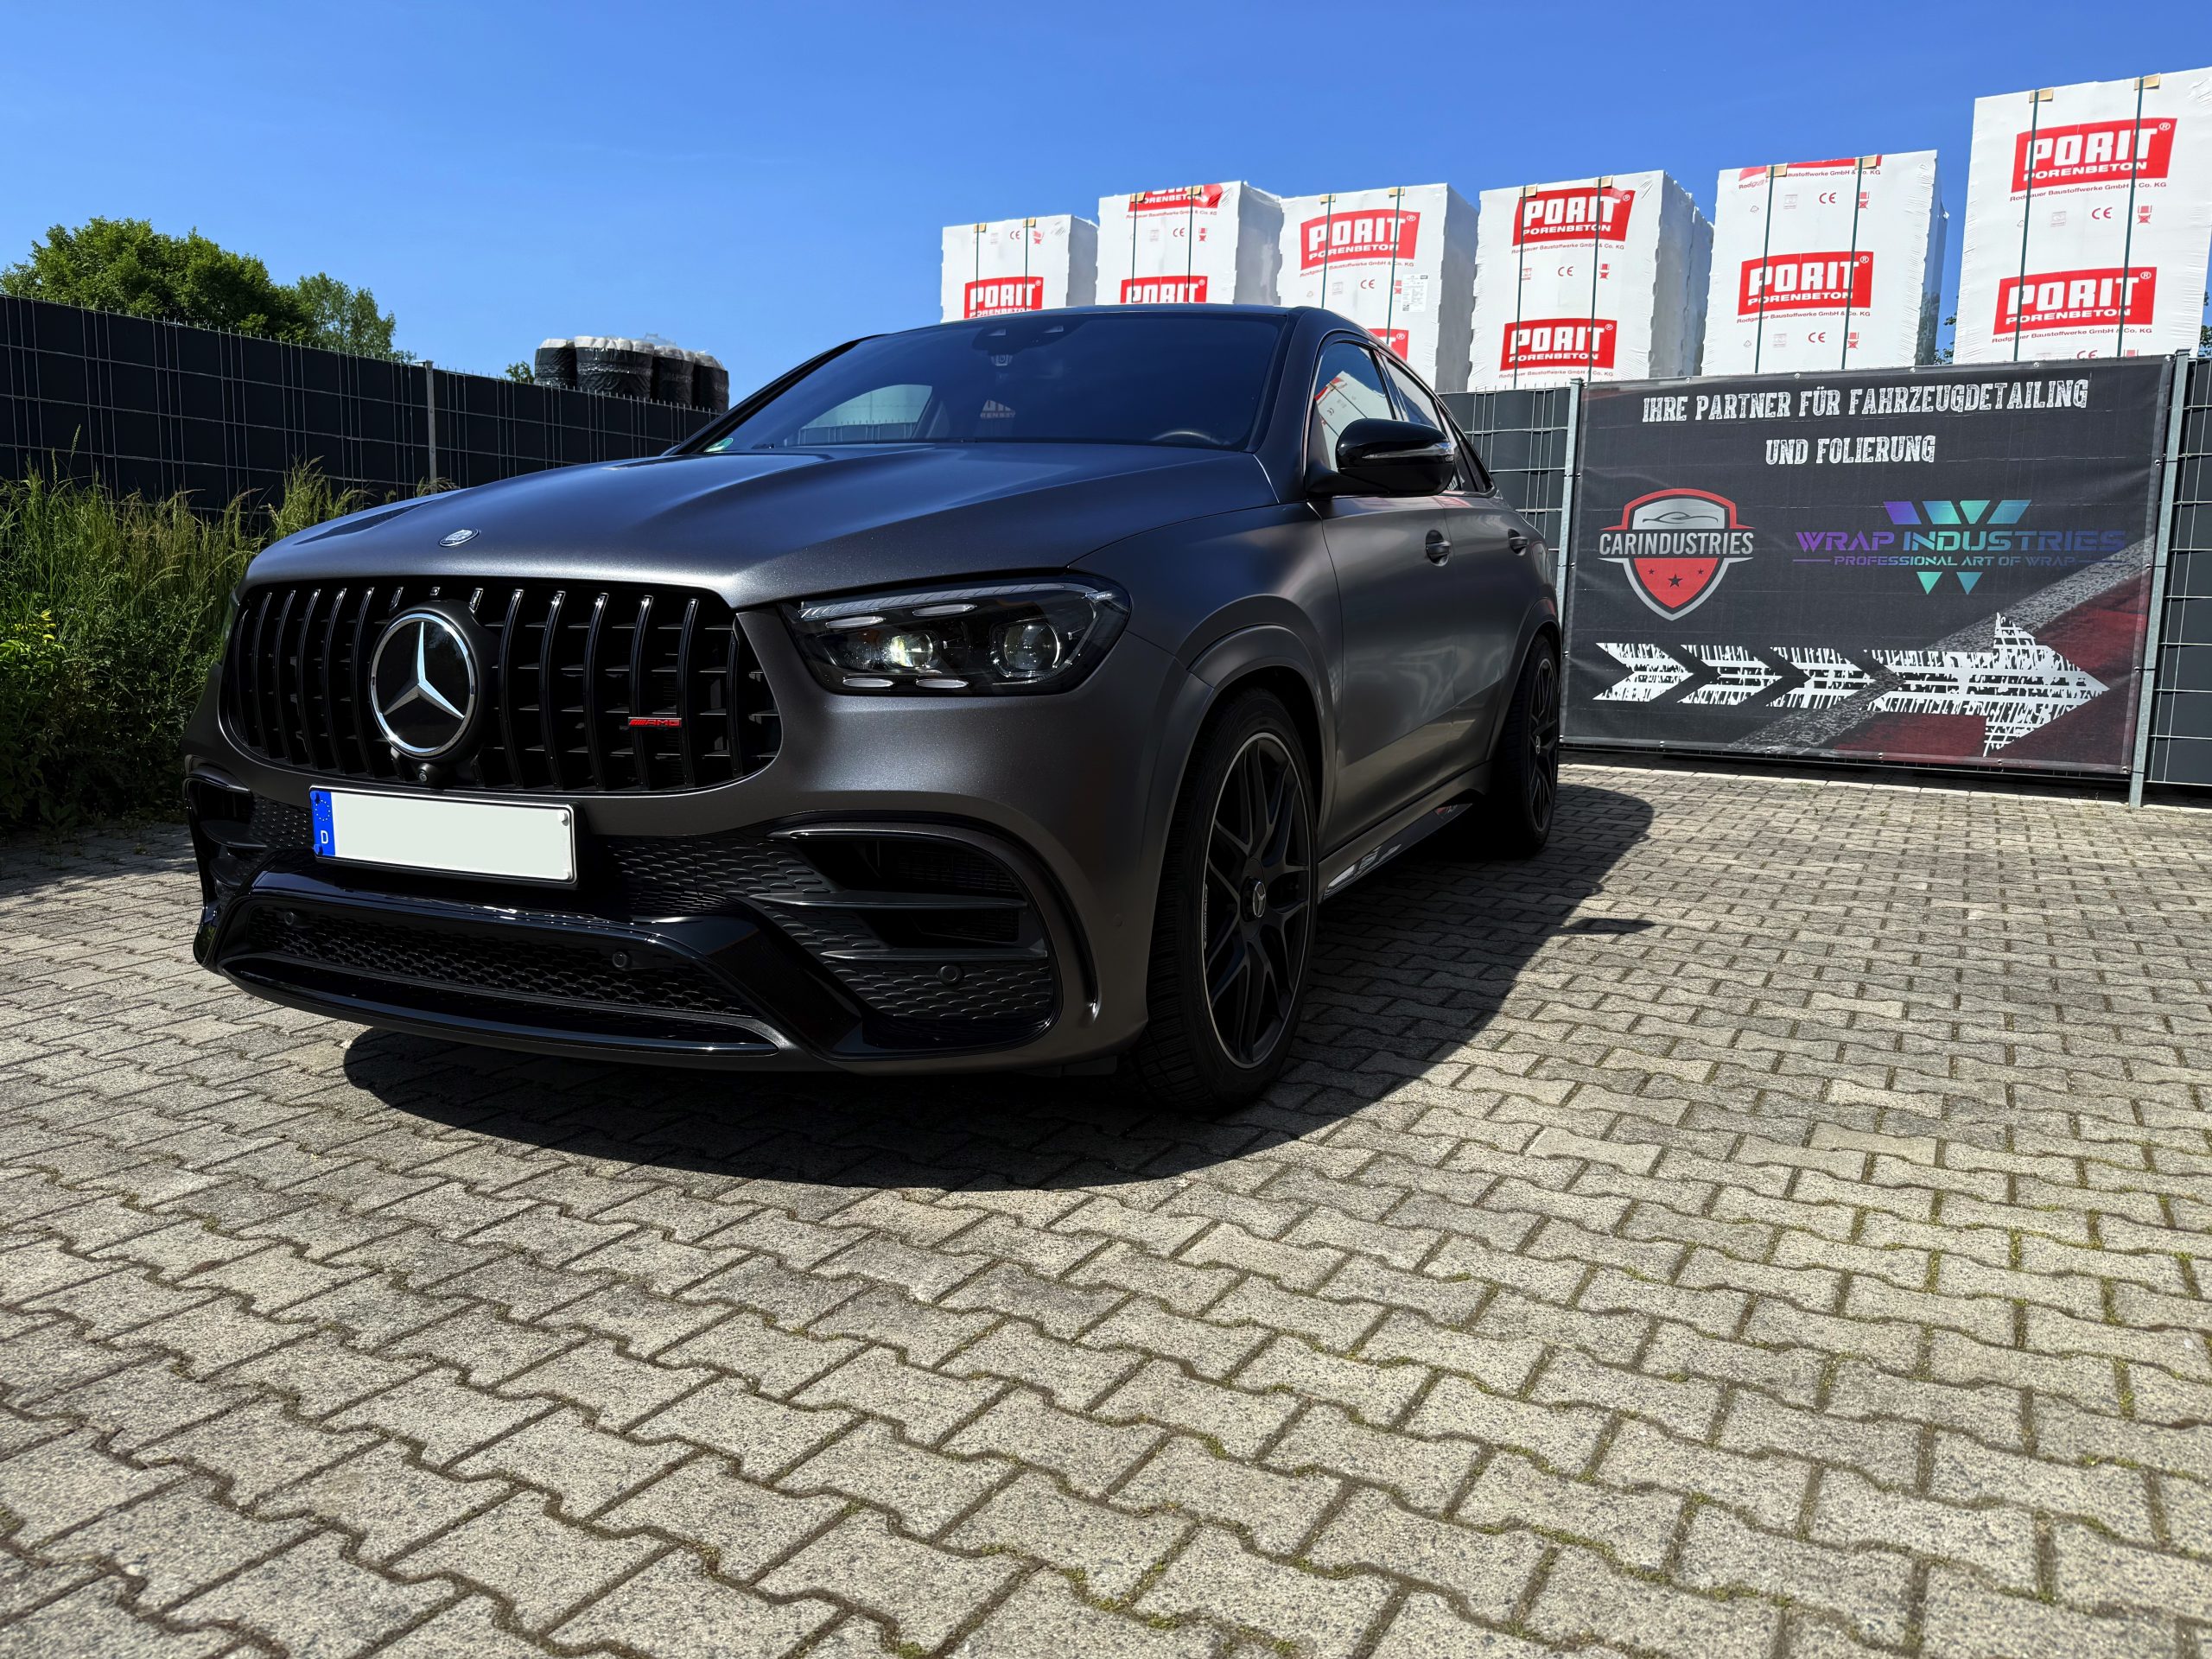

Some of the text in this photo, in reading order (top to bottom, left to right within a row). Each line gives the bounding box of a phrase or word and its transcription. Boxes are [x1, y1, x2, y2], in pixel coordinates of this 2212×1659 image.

[2023, 162, 2147, 181] PORENBETON
[1309, 244, 1399, 260] PORENBETON
[1747, 291, 1853, 307] PORENBETON
[2005, 308, 2131, 325] PORENBETON
[1643, 379, 2089, 423] IHRE PARTNER FÜR FAHRZEUGDETAILING
[1765, 435, 1936, 466] UND FOLIERUNG
[1599, 531, 1754, 555] CARINDUSTRIES
[1795, 531, 2127, 552] WRAP INDUSTRIES
[1834, 556, 2075, 567] PROFESSIONAL ART OF WRAP
[321, 830, 329, 844] D
